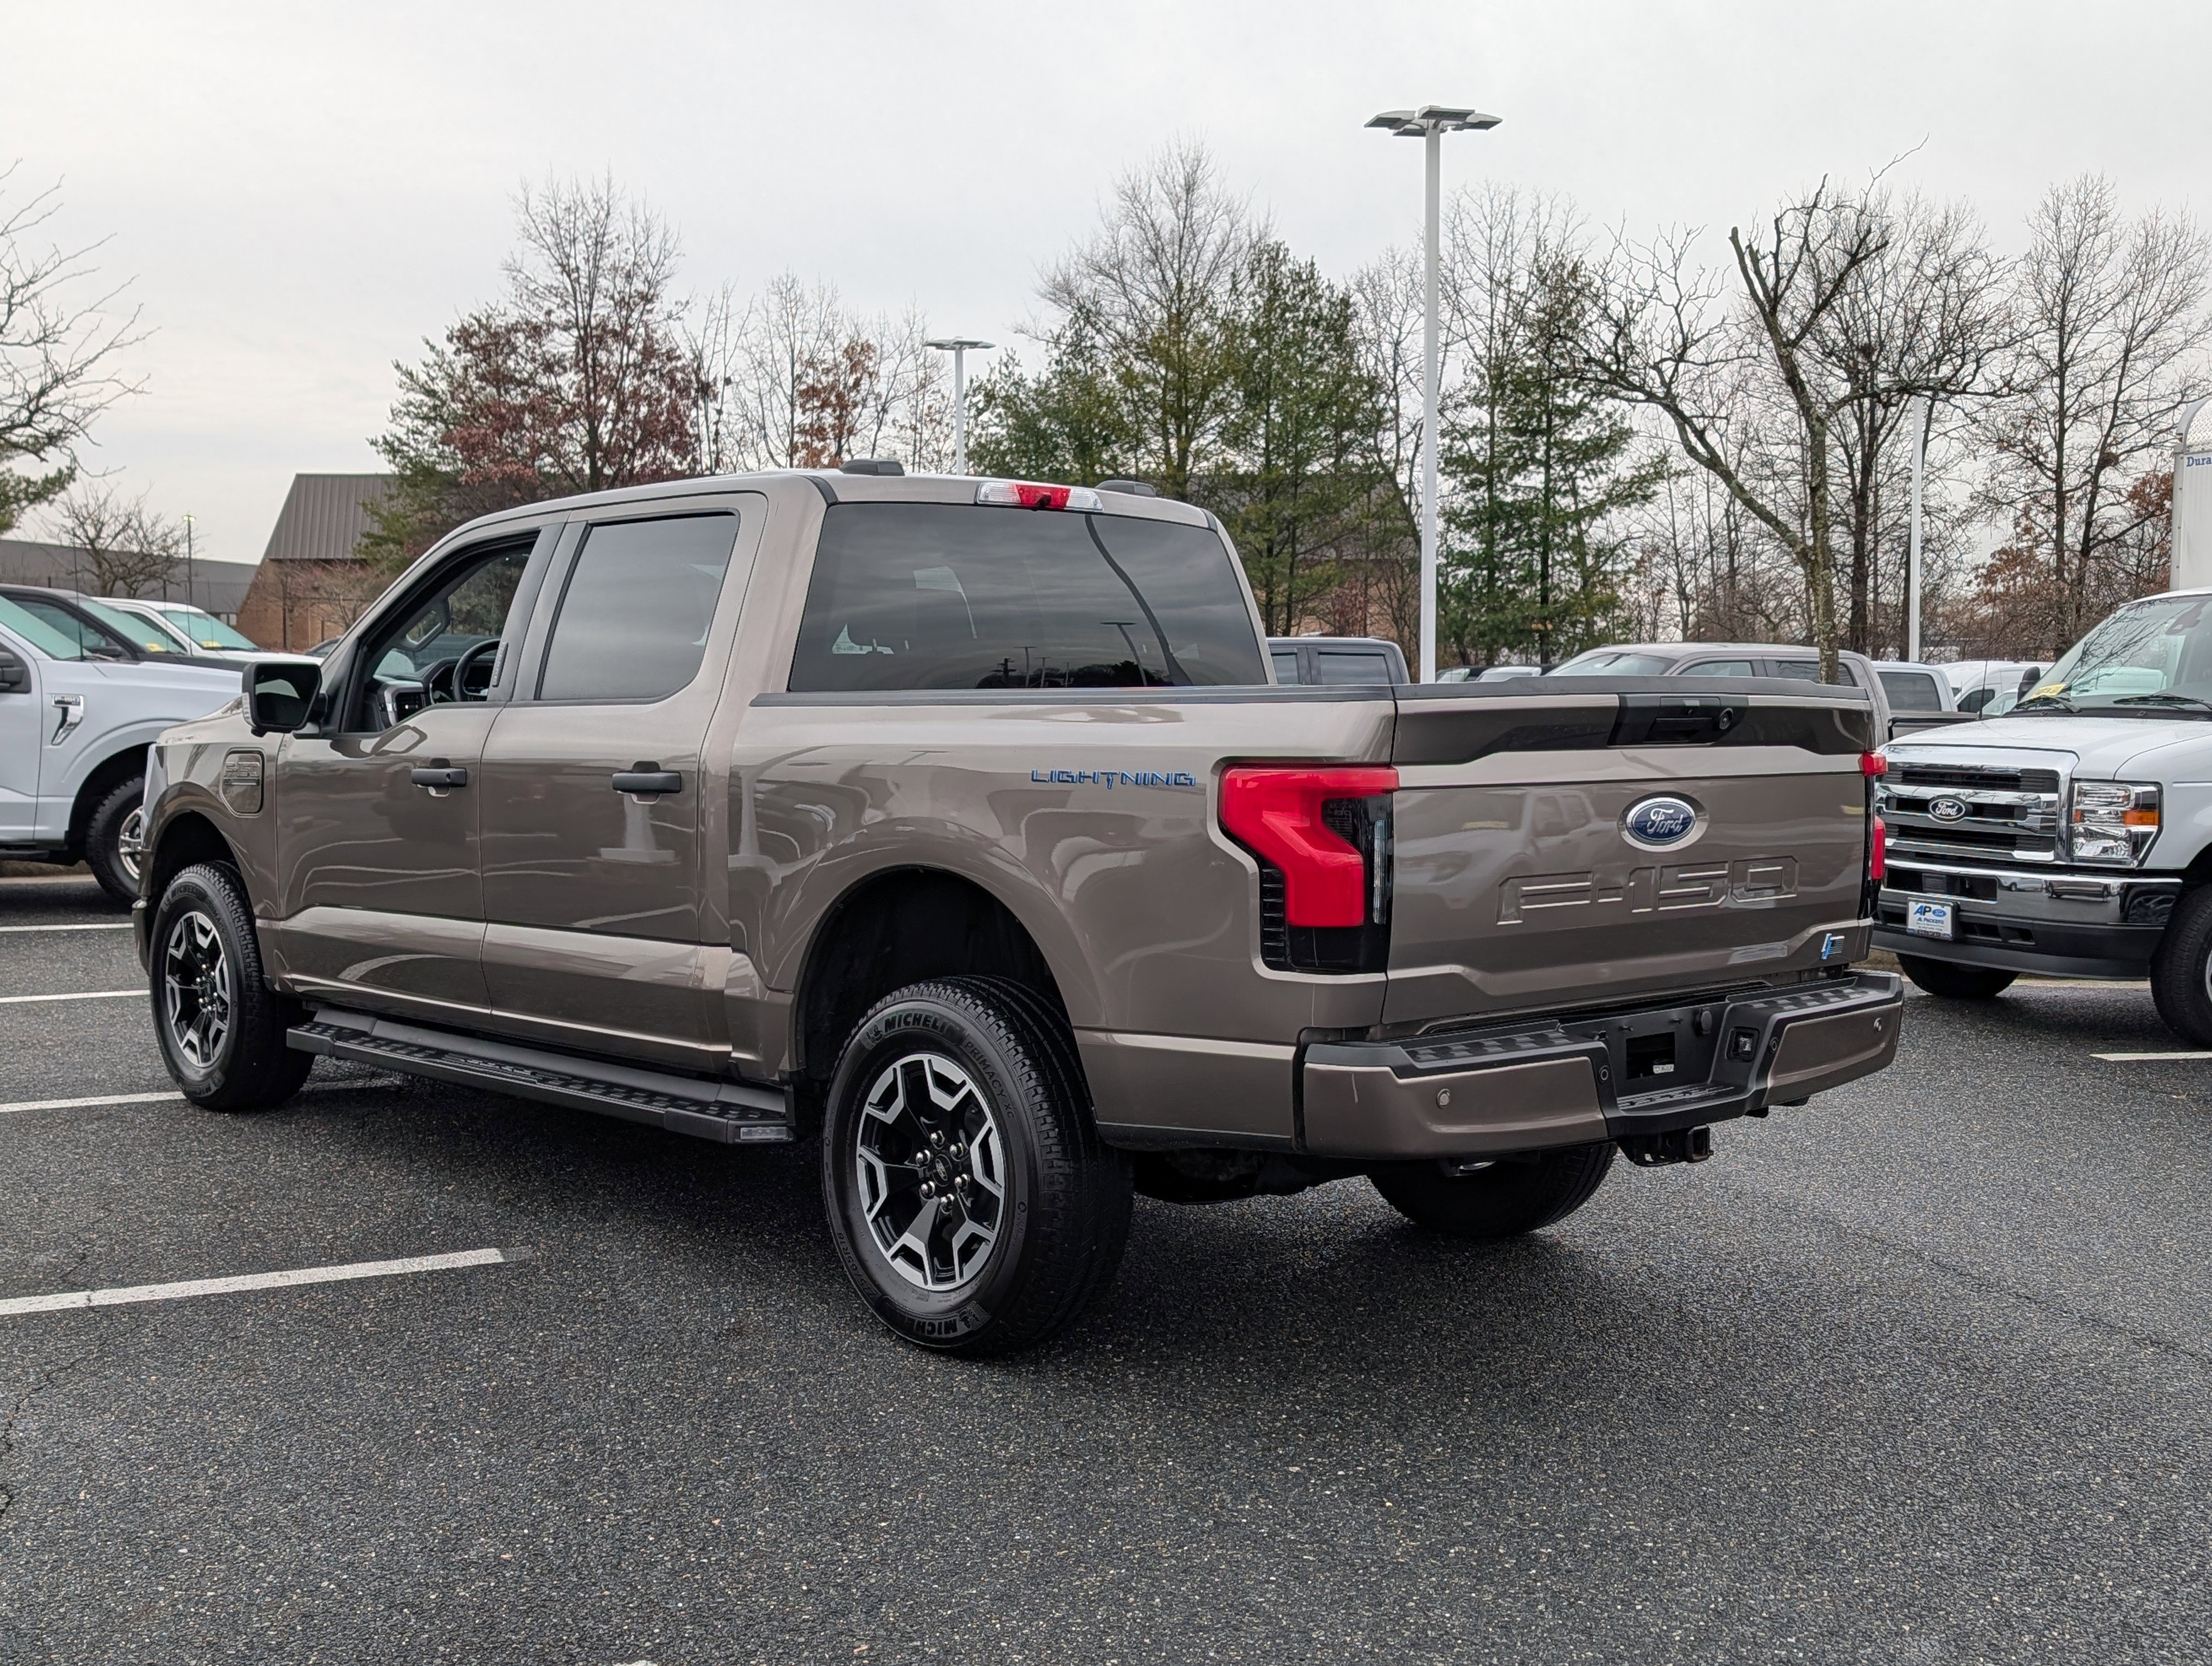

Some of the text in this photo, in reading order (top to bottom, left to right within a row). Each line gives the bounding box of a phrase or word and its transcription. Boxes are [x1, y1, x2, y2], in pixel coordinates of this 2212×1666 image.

[1031, 769, 1196, 790] LIGHTNING
[1935, 801, 1958, 816] Ford
[1647, 808, 1684, 835] Ford
[1496, 855, 1799, 926] F-150
[1913, 905, 1932, 916] AP
[964, 1041, 1015, 1119] PRIMACY XC
